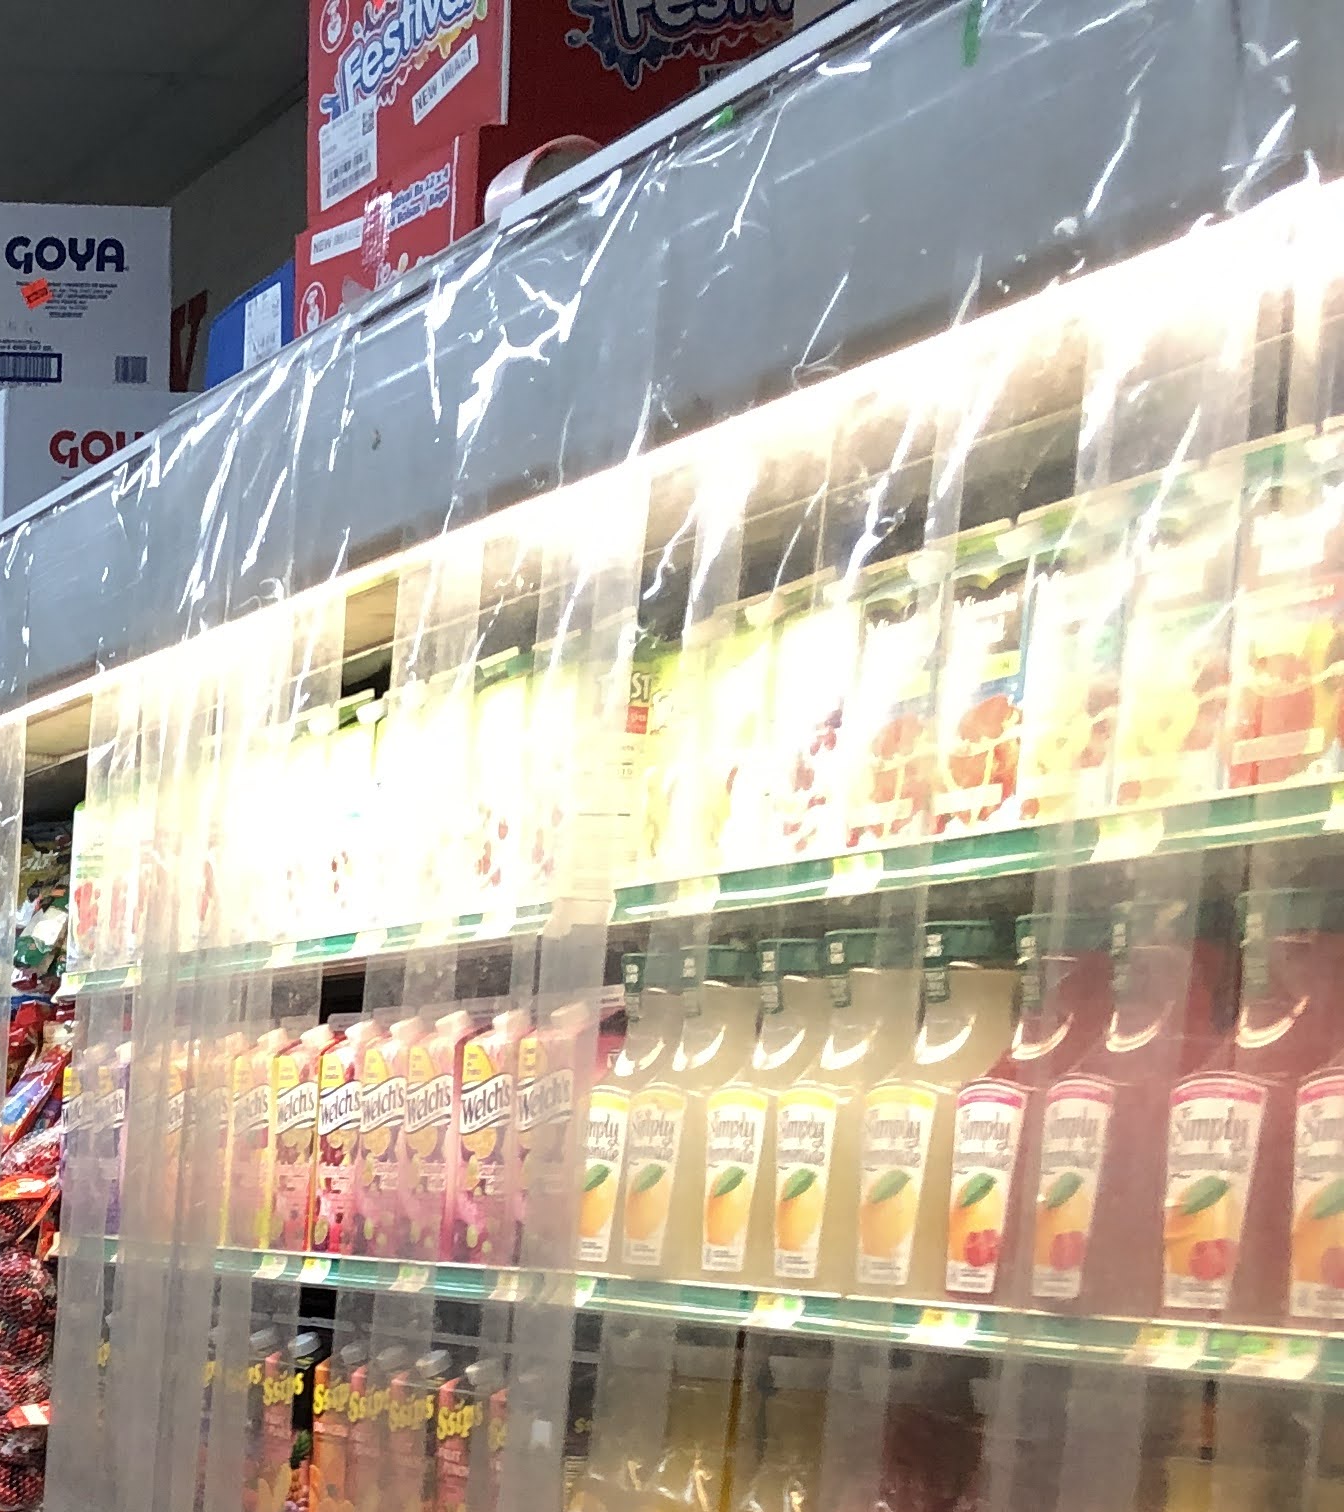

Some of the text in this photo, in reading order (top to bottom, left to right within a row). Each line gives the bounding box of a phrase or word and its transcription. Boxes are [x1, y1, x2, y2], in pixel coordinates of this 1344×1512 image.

[4, 236, 125, 274] GOYA
[319, 1085, 361, 1127] Welch's
[362, 1082, 406, 1124] Welch's
[407, 1081, 452, 1122] Welch's
[462, 1079, 511, 1122] Welch's
